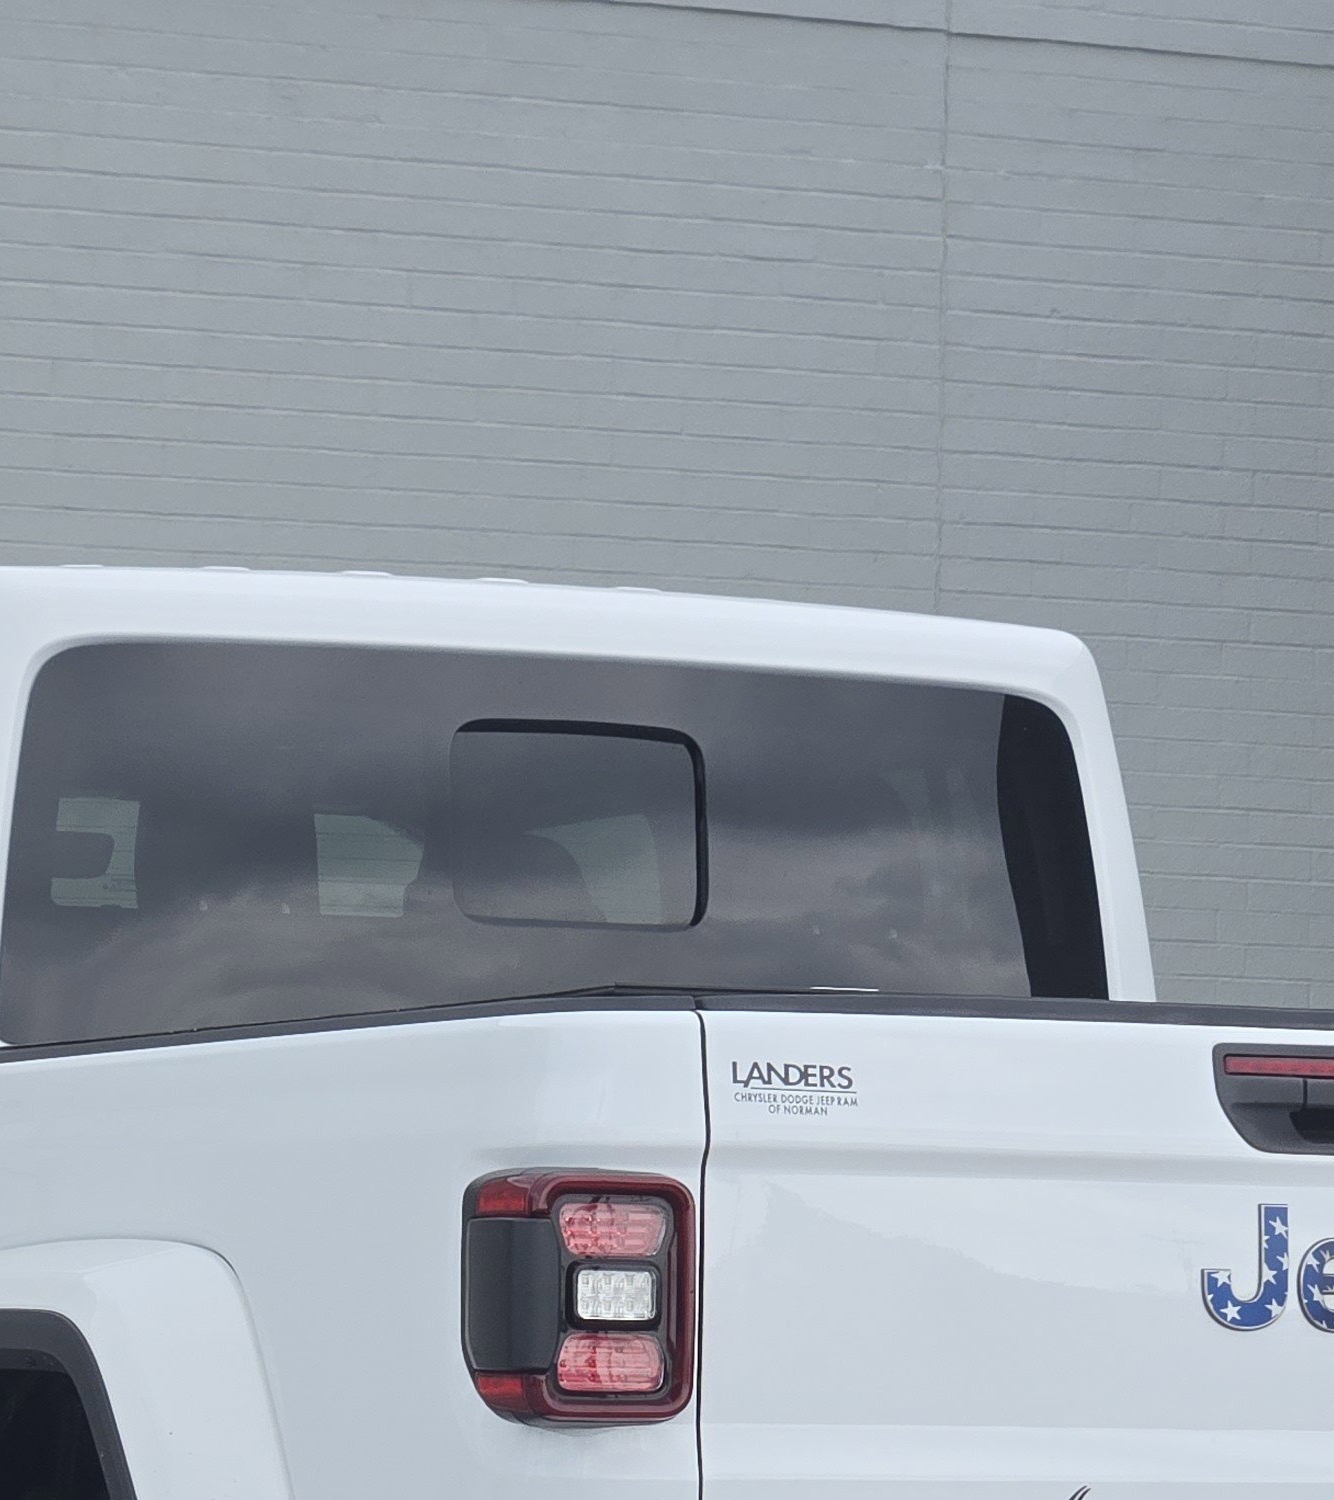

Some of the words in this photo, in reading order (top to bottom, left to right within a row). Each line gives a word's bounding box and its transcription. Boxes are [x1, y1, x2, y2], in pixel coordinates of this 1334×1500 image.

[732, 1061, 854, 1089] LANDERS
[734, 1092, 778, 1104] CHRYSLER
[781, 1094, 814, 1105] DODGE
[816, 1095, 835, 1106] JEEP
[836, 1096, 858, 1107] RAM
[768, 1104, 780, 1114] OF
[783, 1105, 828, 1116] NORMAN
